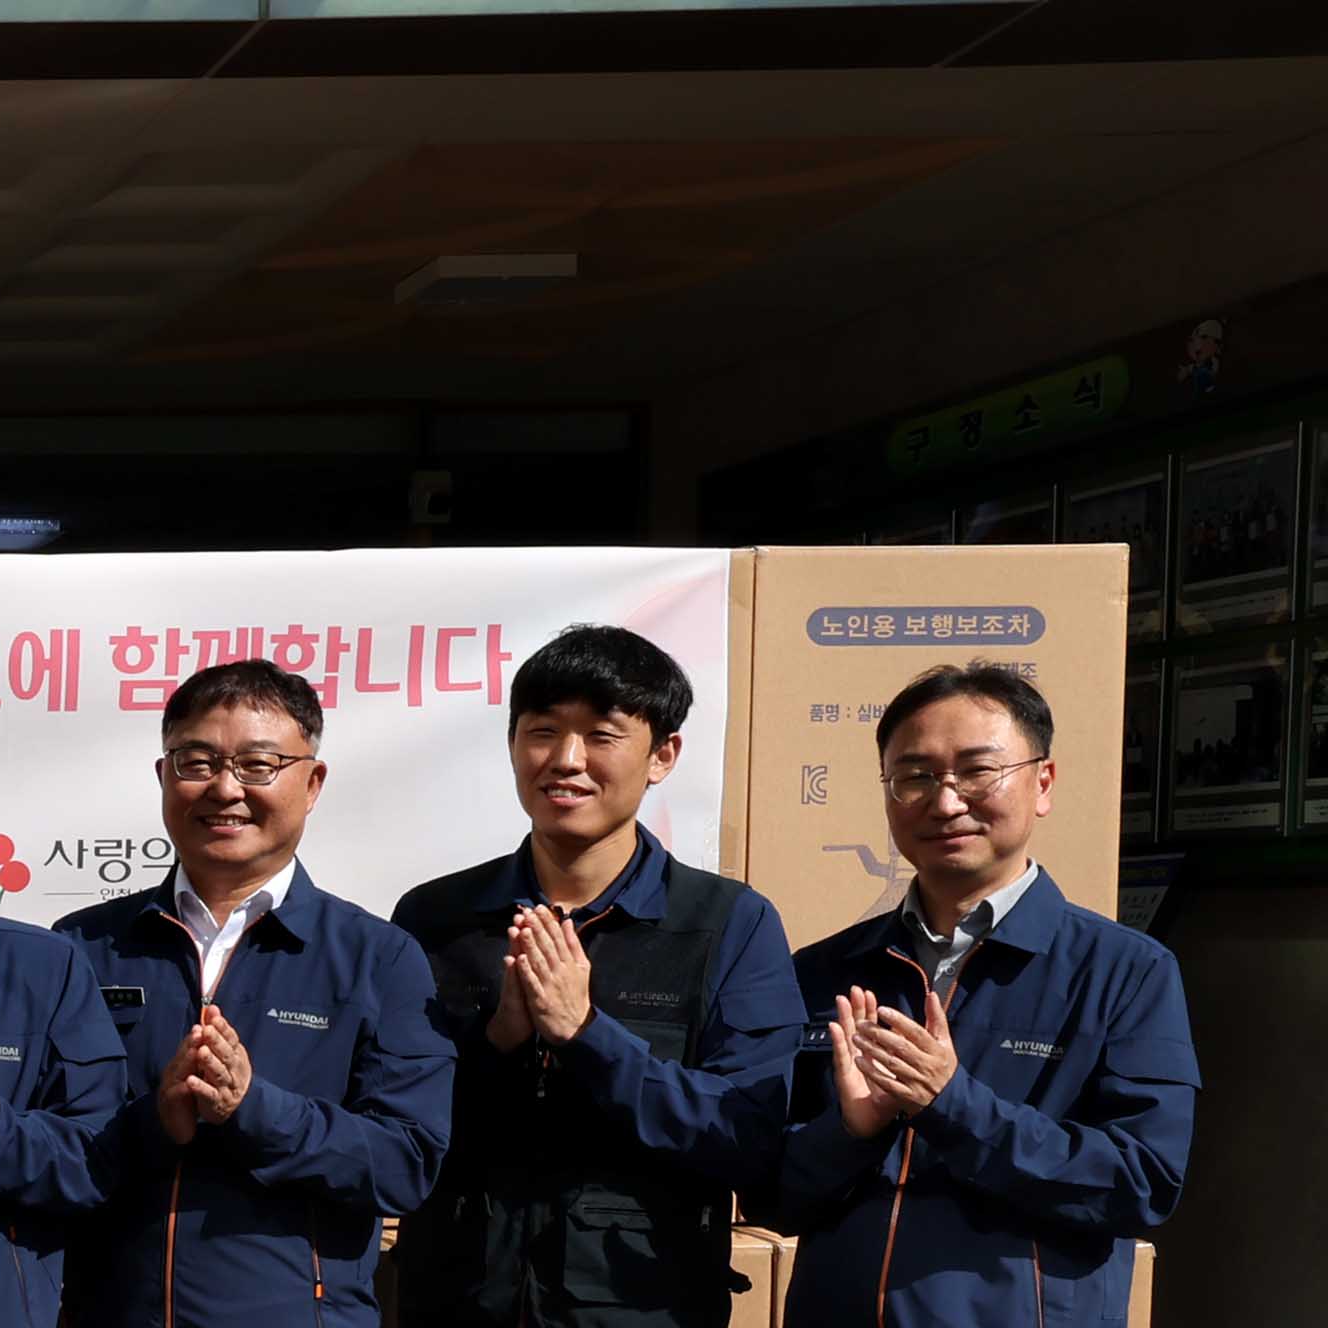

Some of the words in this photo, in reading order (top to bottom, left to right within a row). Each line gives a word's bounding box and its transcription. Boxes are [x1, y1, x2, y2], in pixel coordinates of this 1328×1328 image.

[906, 370, 1103, 464] 구정소식
[820, 614, 896, 638] 노인용
[903, 613, 1031, 638] 보행보조차
[809, 703, 840, 722] 품명
[857, 703, 887, 723] 실버
[279, 1010, 329, 1025] HYUNDAI
